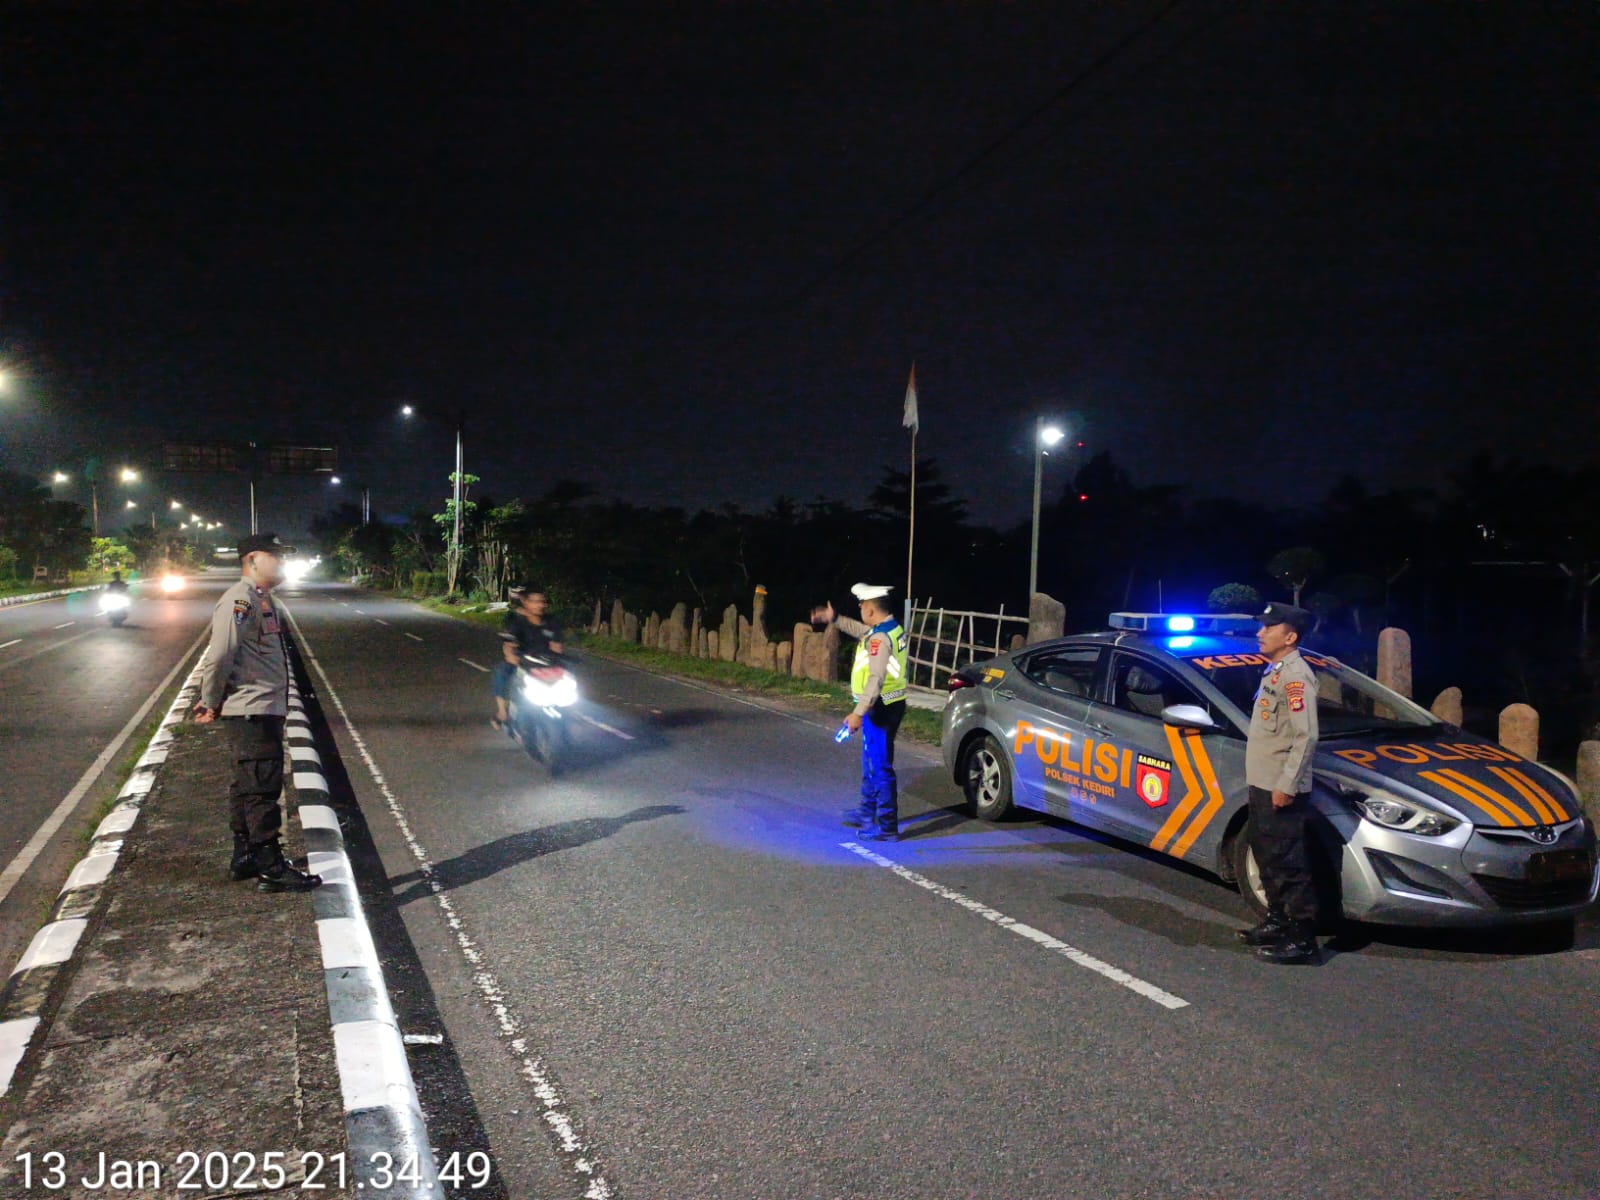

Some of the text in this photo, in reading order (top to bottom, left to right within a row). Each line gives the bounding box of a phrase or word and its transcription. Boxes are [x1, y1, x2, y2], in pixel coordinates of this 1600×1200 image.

[1014, 719, 1134, 789] POLISI
[1138, 755, 1171, 771] SABHARA
[1333, 742, 1523, 770] POLISI
[1045, 767, 1080, 787] POLSEK
[1082, 779, 1116, 798] KEDIRI
